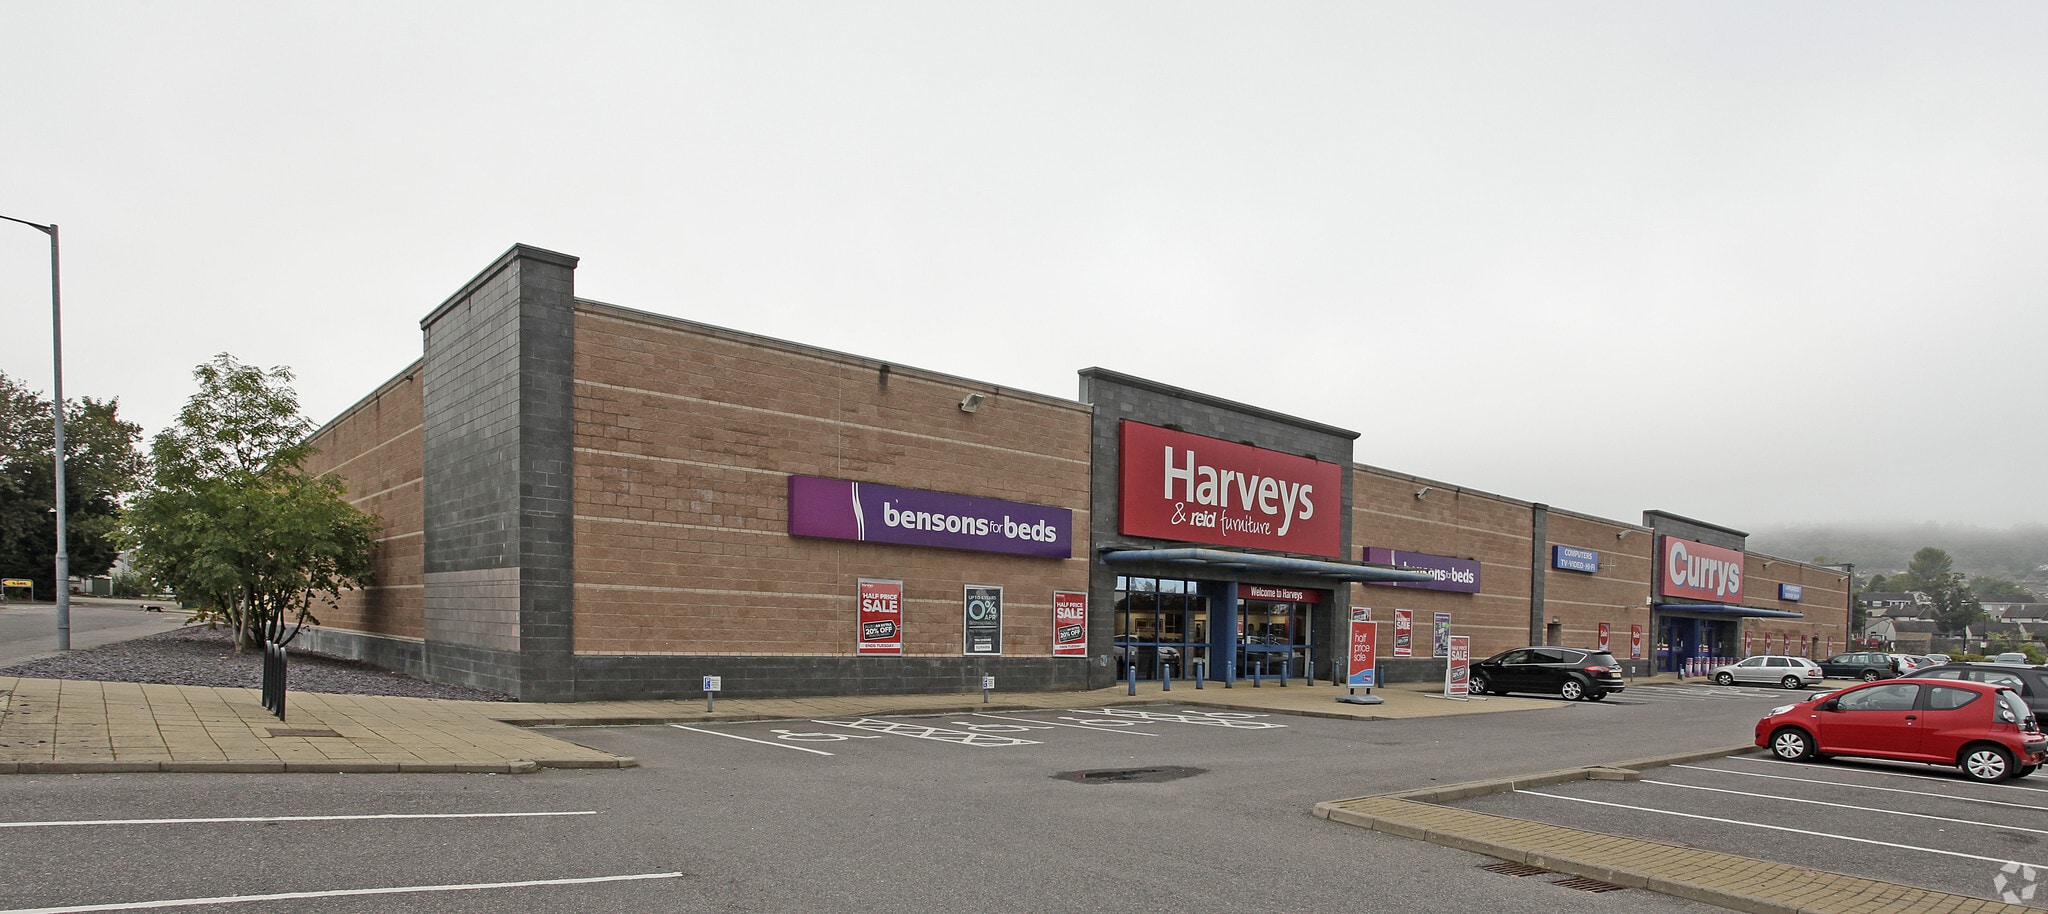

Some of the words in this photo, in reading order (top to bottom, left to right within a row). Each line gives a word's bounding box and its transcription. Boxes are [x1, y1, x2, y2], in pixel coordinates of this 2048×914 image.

[1164, 445, 1314, 536] Harveys
[883, 502, 989, 536] bensons
[989, 520, 1003, 534] for
[1004, 515, 1057, 543] beds
[1171, 502, 1186, 525] &
[1190, 511, 1217, 528] reid
[1220, 509, 1271, 537] furniture
[1564, 548, 1593, 560] COMPUTERS
[1451, 567, 1474, 584] beds
[1669, 541, 1740, 598] Currys
[1250, 586, 1275, 598] Welcome
[1276, 589, 1282, 598] to
[1282, 588, 1303, 601] Harveys
[863, 599, 898, 613] SALE
[968, 600, 997, 620] 0%
[1057, 607, 1084, 619] SALE
[1396, 621, 1411, 630] SALE
[1354, 633, 1367, 642] half
[1354, 643, 1370, 653] price
[1353, 652, 1366, 661] sale
[1451, 651, 1467, 660] SALE
